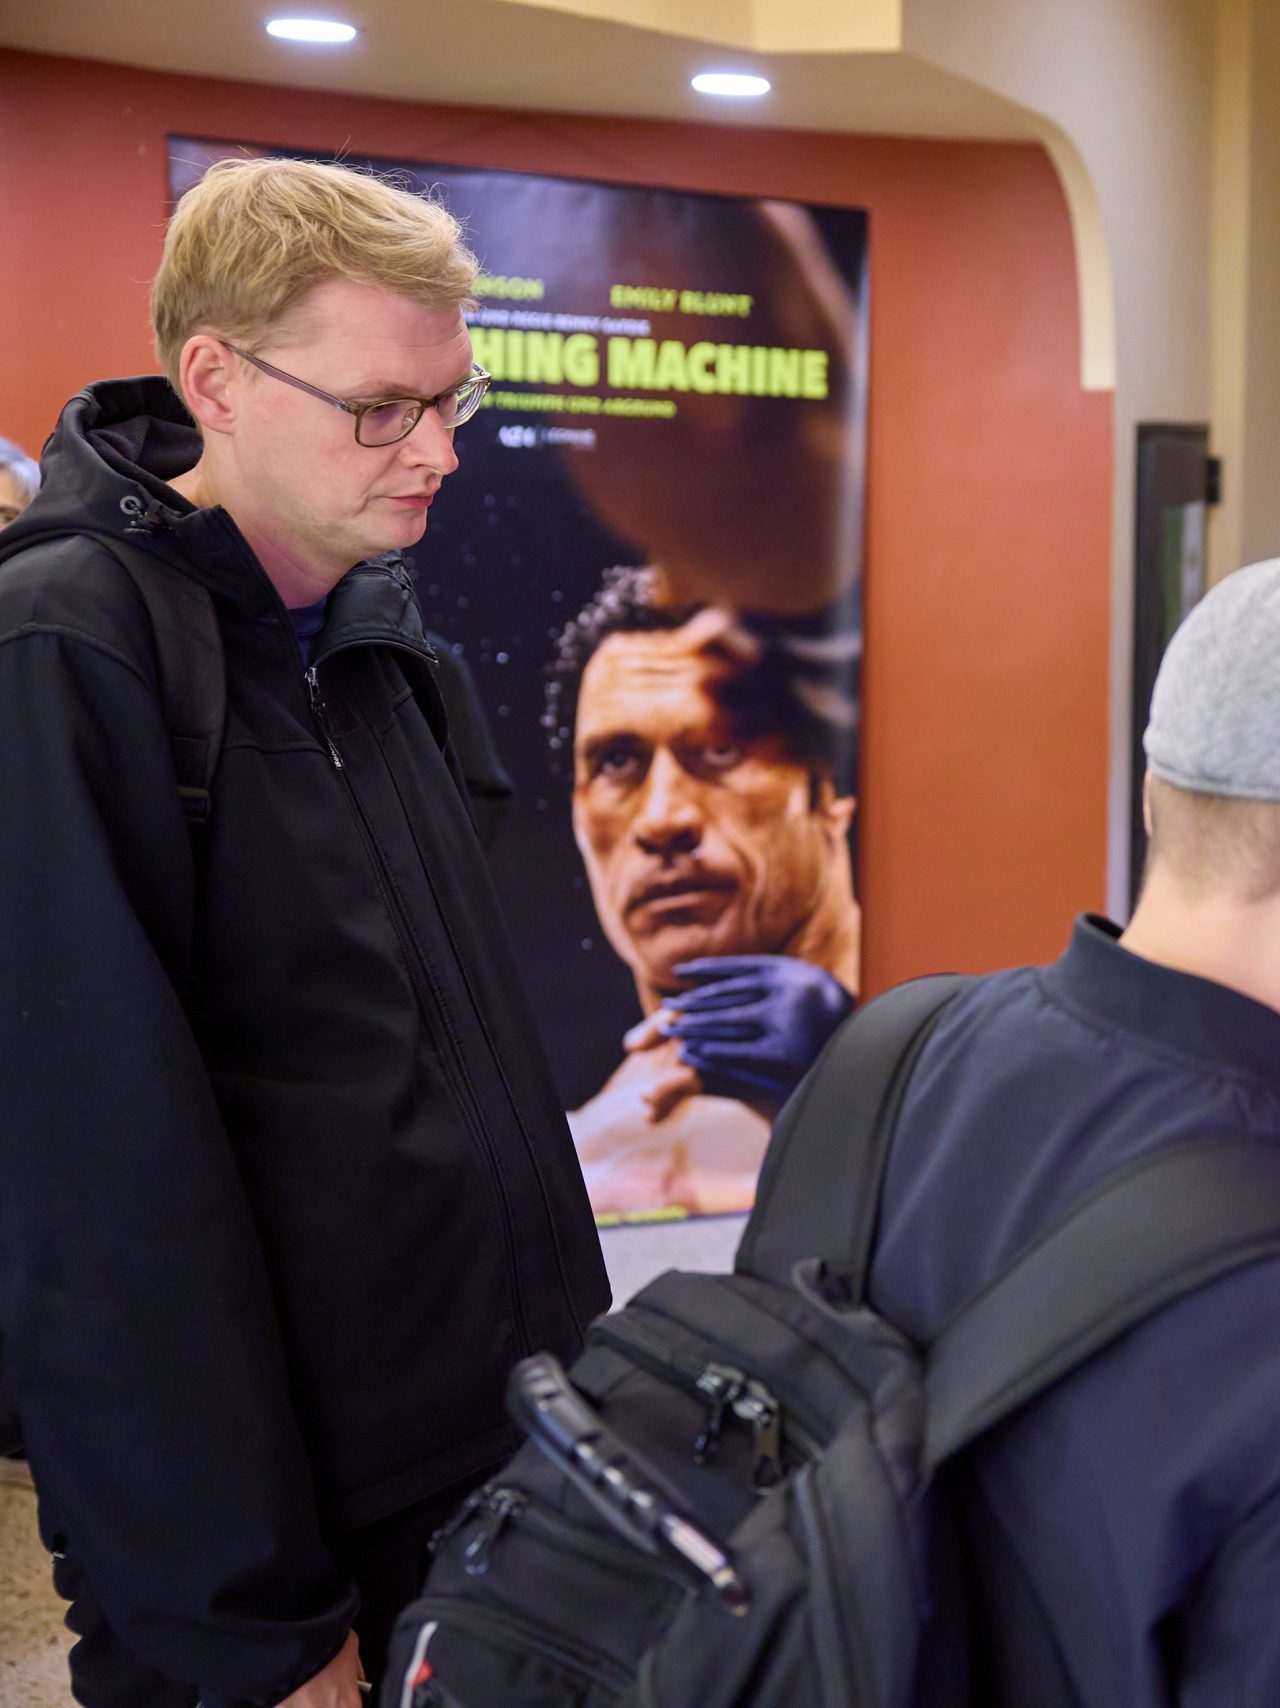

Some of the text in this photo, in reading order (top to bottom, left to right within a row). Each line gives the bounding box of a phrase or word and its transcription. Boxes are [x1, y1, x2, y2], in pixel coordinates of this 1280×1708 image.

[610, 284, 754, 318] EMILY BLUNT
[469, 327, 829, 400] HING MACHINE
